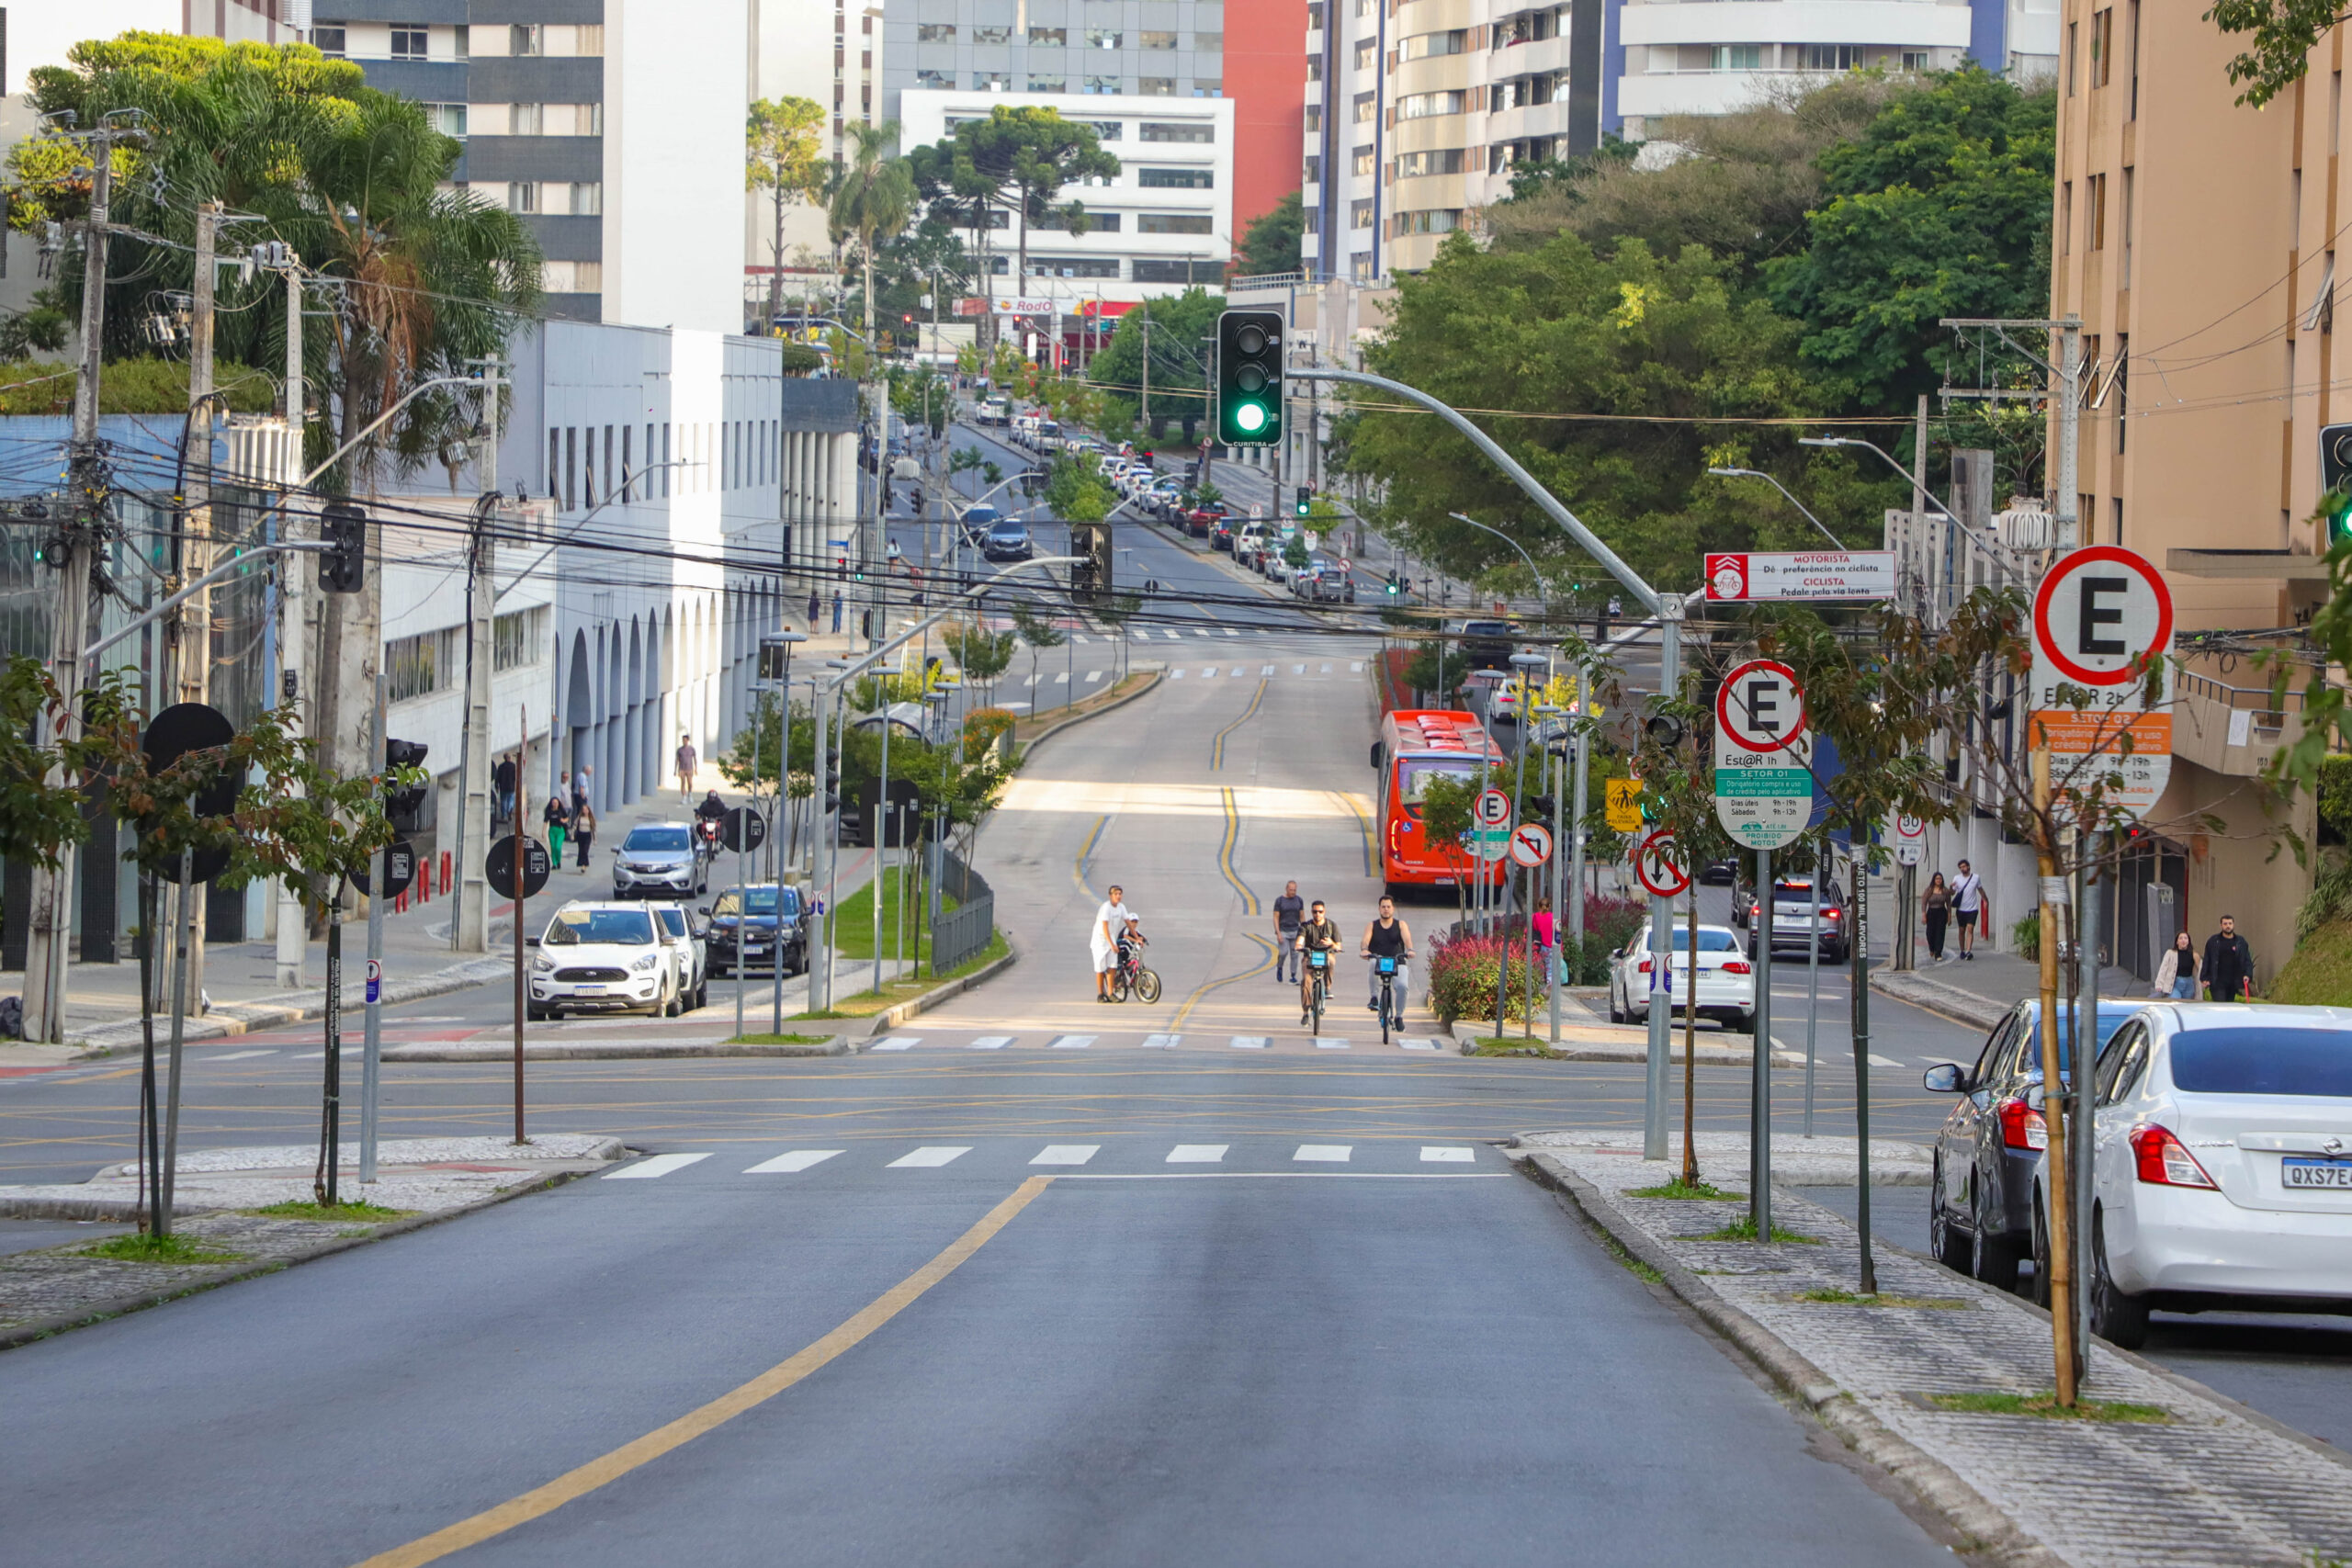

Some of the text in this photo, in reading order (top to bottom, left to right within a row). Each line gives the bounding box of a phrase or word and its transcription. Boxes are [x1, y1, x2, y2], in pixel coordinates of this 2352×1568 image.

[1793, 555, 1850, 563] MOTORISTA
[1763, 565, 1776, 573] Dê
[1782, 565, 1833, 575] preferência
[1848, 565, 1879, 573] ciclista
[1803, 578, 1845, 586] CICLISTA
[1781, 588, 1810, 596] Pedale
[1812, 588, 1830, 597] pela
[2078, 577, 2128, 655] E
[2106, 692, 2124, 705] 2h
[1748, 681, 1780, 731] E
[2113, 714, 2132, 724] 02
[1725, 754, 1777, 768] Est@R 1h
[2132, 757, 2151, 766] 19h
[2132, 770, 2151, 780] 13h
[1726, 780, 1760, 788] Obrigatório
[1486, 797, 1498, 817] E
[1859, 919, 1867, 958] ÁRVORES
